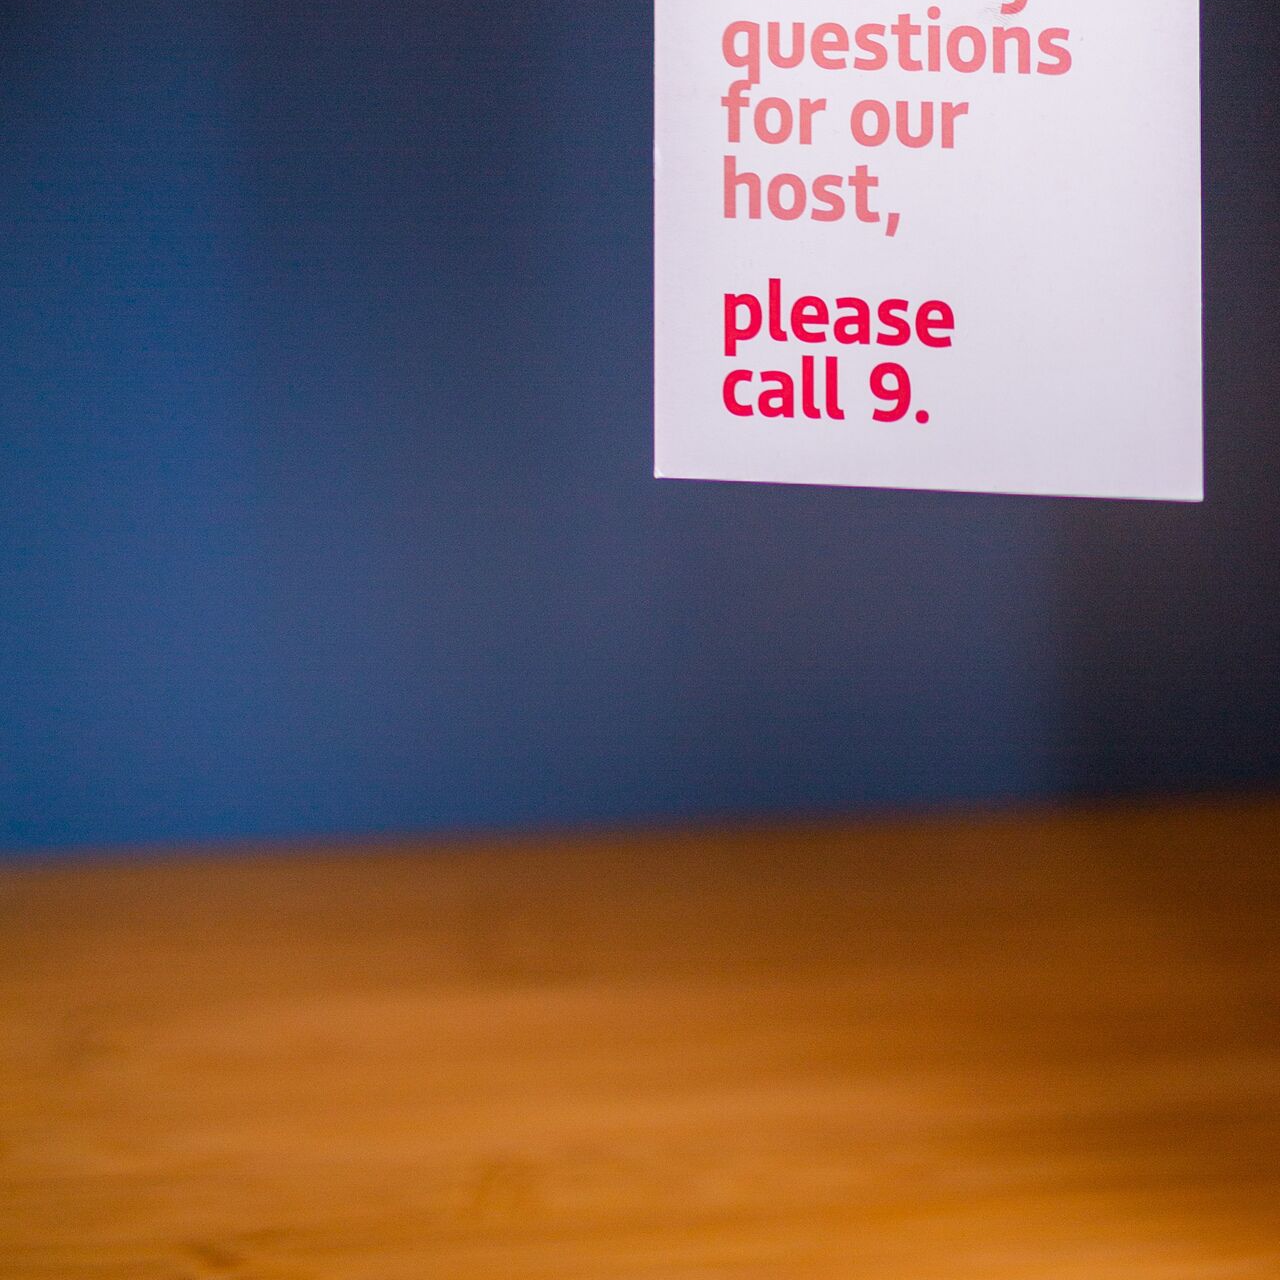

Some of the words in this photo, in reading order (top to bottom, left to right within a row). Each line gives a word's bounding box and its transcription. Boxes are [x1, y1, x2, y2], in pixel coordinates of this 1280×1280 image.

[720, 6, 1073, 84] questions
[720, 80, 828, 146] for
[849, 99, 970, 150] our
[722, 154, 901, 238] host,
[722, 276, 957, 358] please
[721, 354, 847, 422] call
[867, 360, 931, 426] 9.
